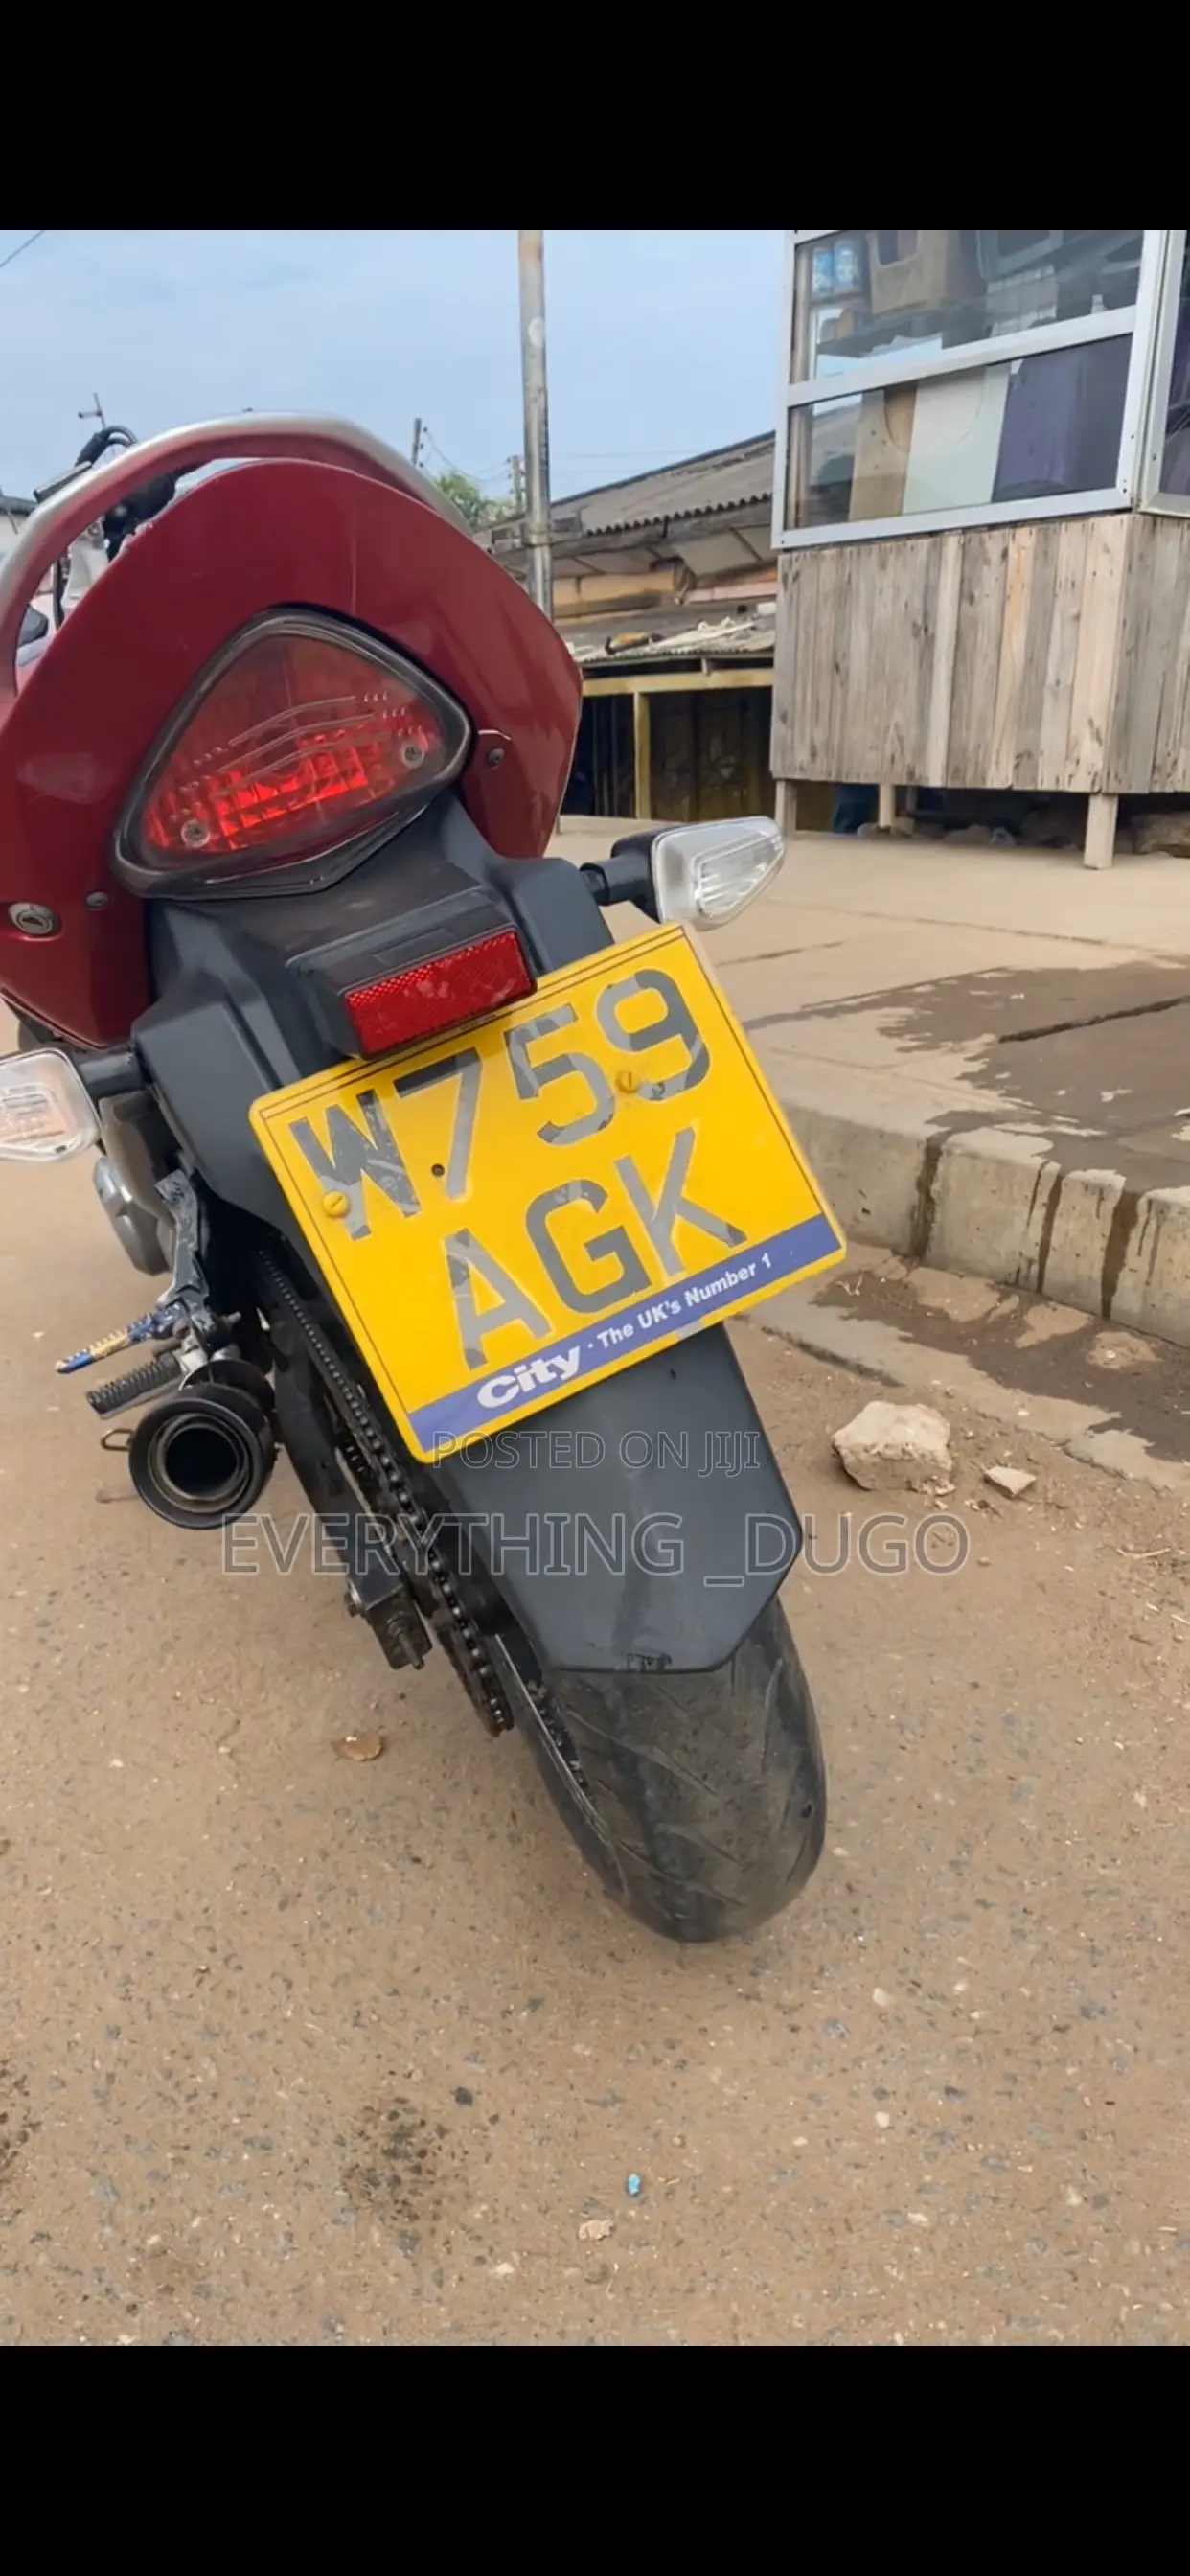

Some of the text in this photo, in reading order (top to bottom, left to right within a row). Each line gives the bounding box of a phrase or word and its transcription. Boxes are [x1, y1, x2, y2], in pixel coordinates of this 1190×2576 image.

[288, 968, 711, 1242] W759
[440, 1126, 748, 1371] AGK
[477, 1253, 772, 1408] City The UK's Number 1
